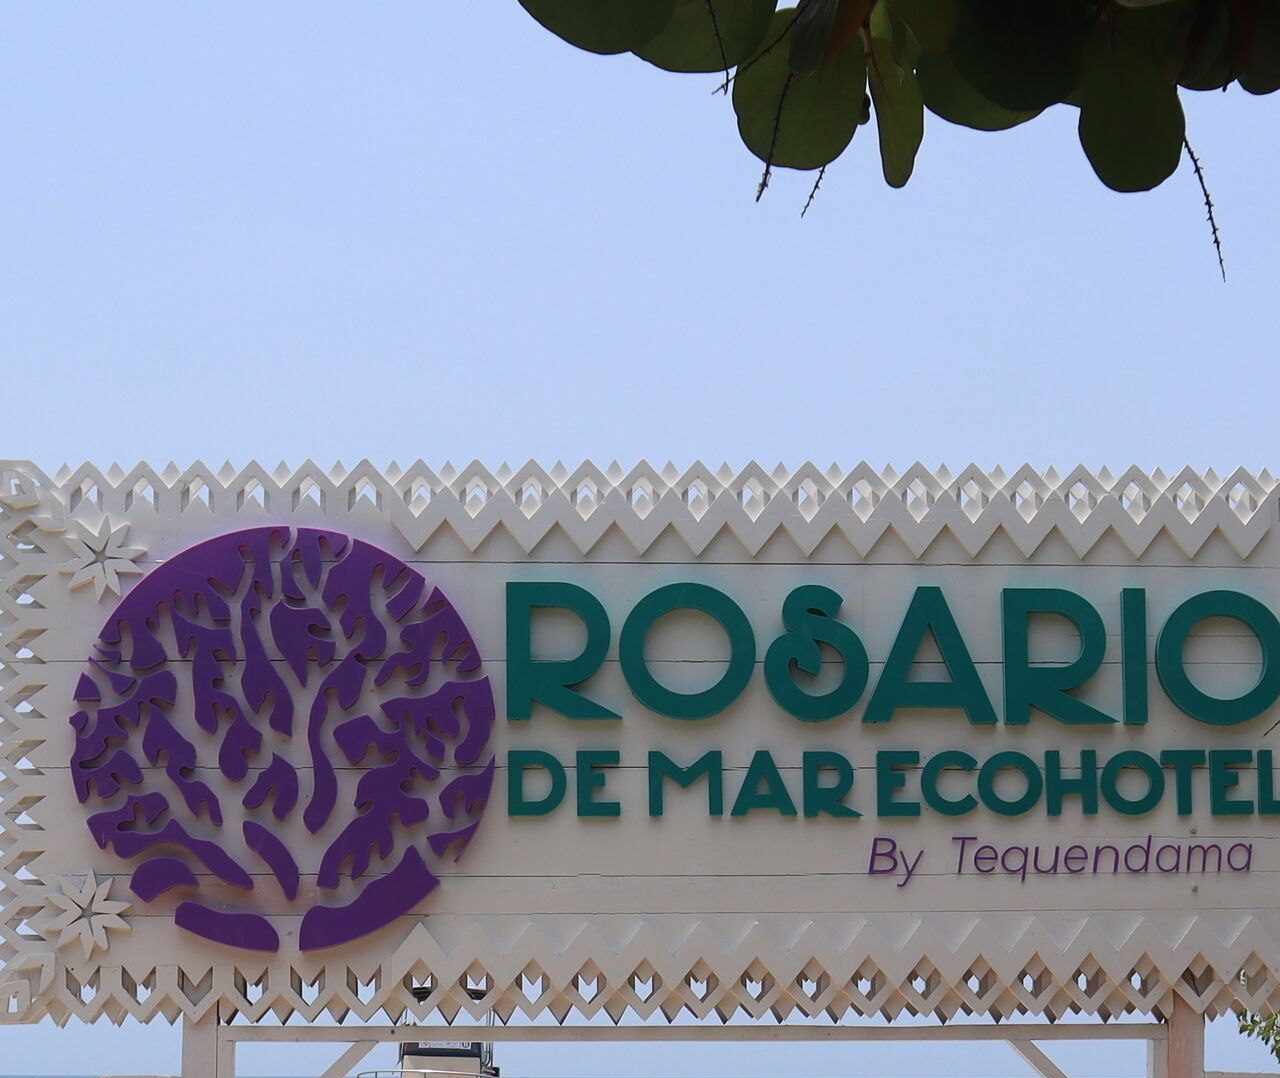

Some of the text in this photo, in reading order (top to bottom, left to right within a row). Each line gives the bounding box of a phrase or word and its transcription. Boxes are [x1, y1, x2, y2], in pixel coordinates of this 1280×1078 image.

[508, 750, 621, 817] DE
[648, 750, 863, 818] MAR
[868, 835, 1254, 887] By Tequendama
